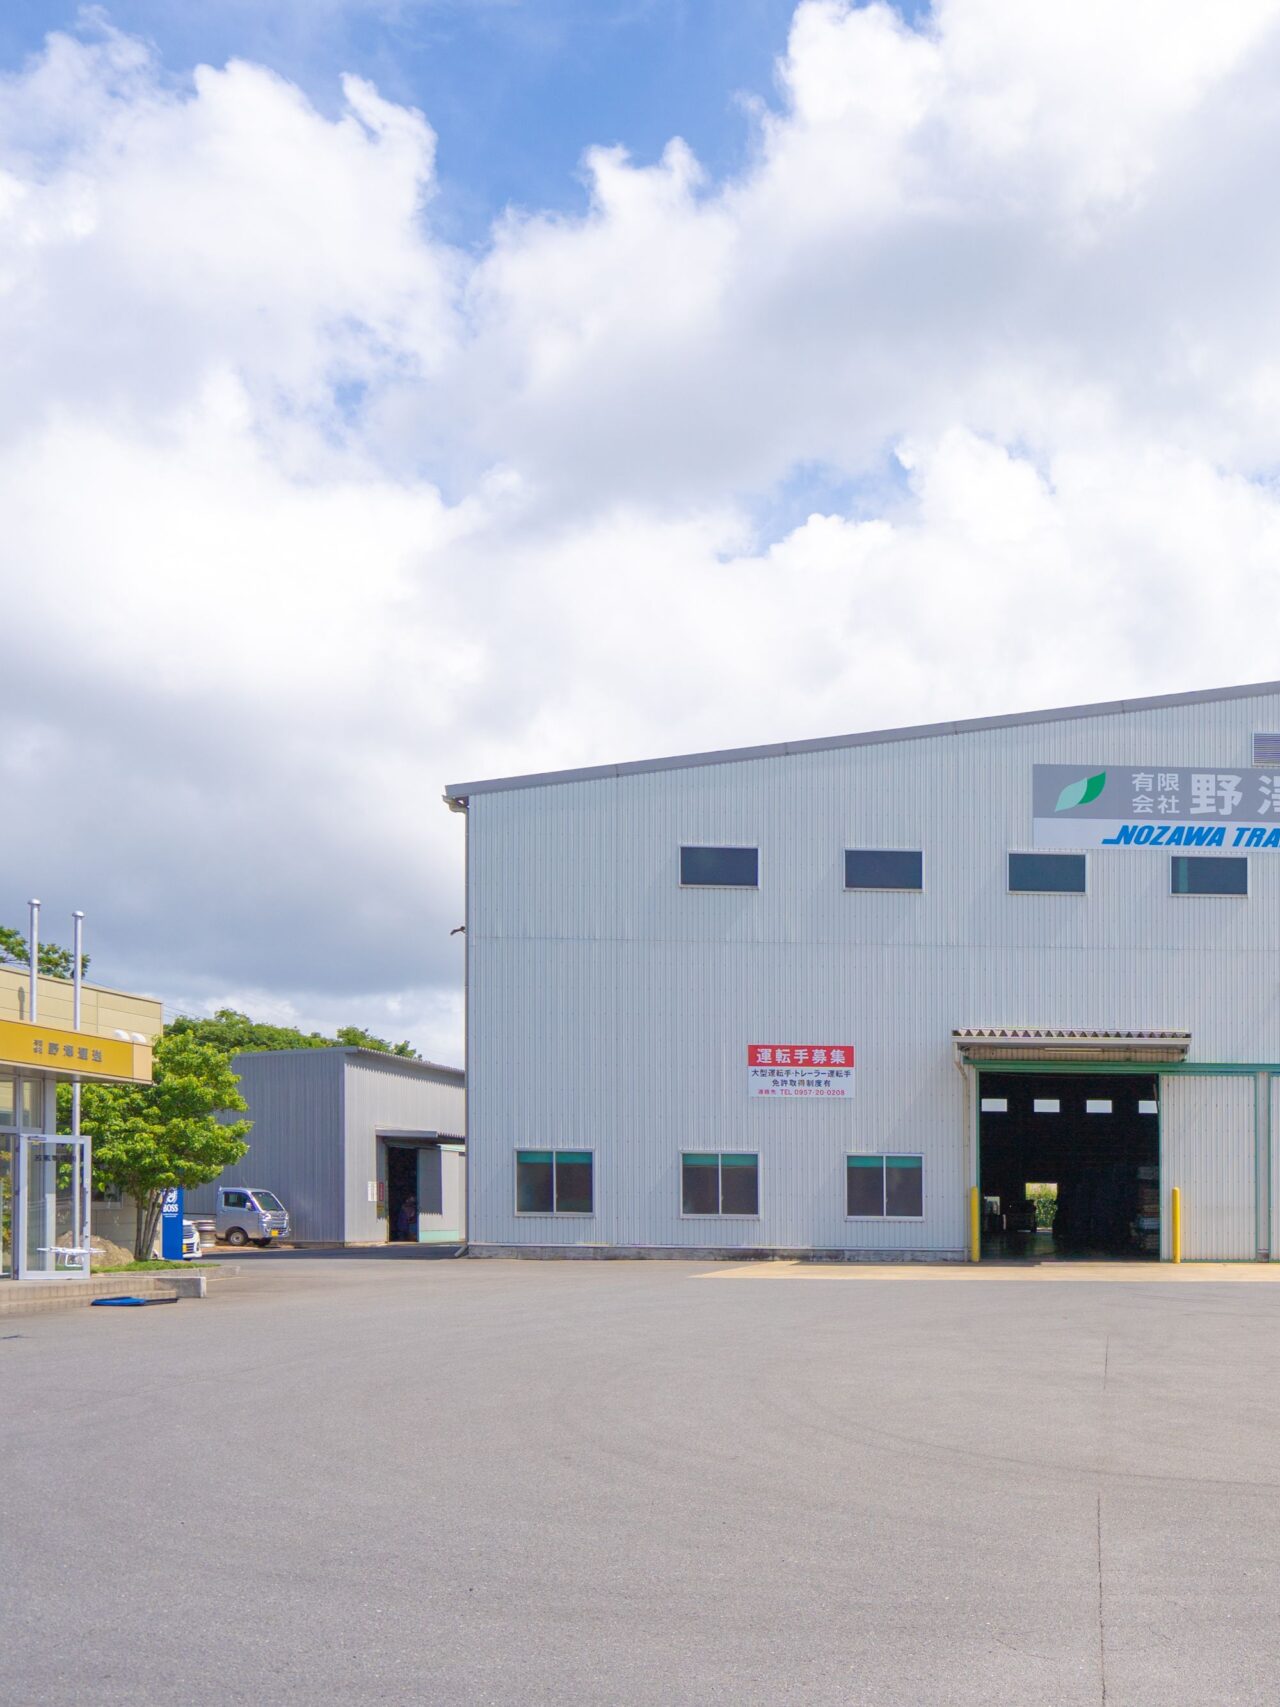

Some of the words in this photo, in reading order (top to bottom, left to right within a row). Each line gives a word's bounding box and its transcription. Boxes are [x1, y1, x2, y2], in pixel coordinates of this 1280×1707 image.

[1131, 772, 1180, 792] 有限
[1132, 794, 1181, 814] 会社
[1102, 825, 1226, 847] NOZAWA
[756, 1048, 846, 1064] 運転手募集
